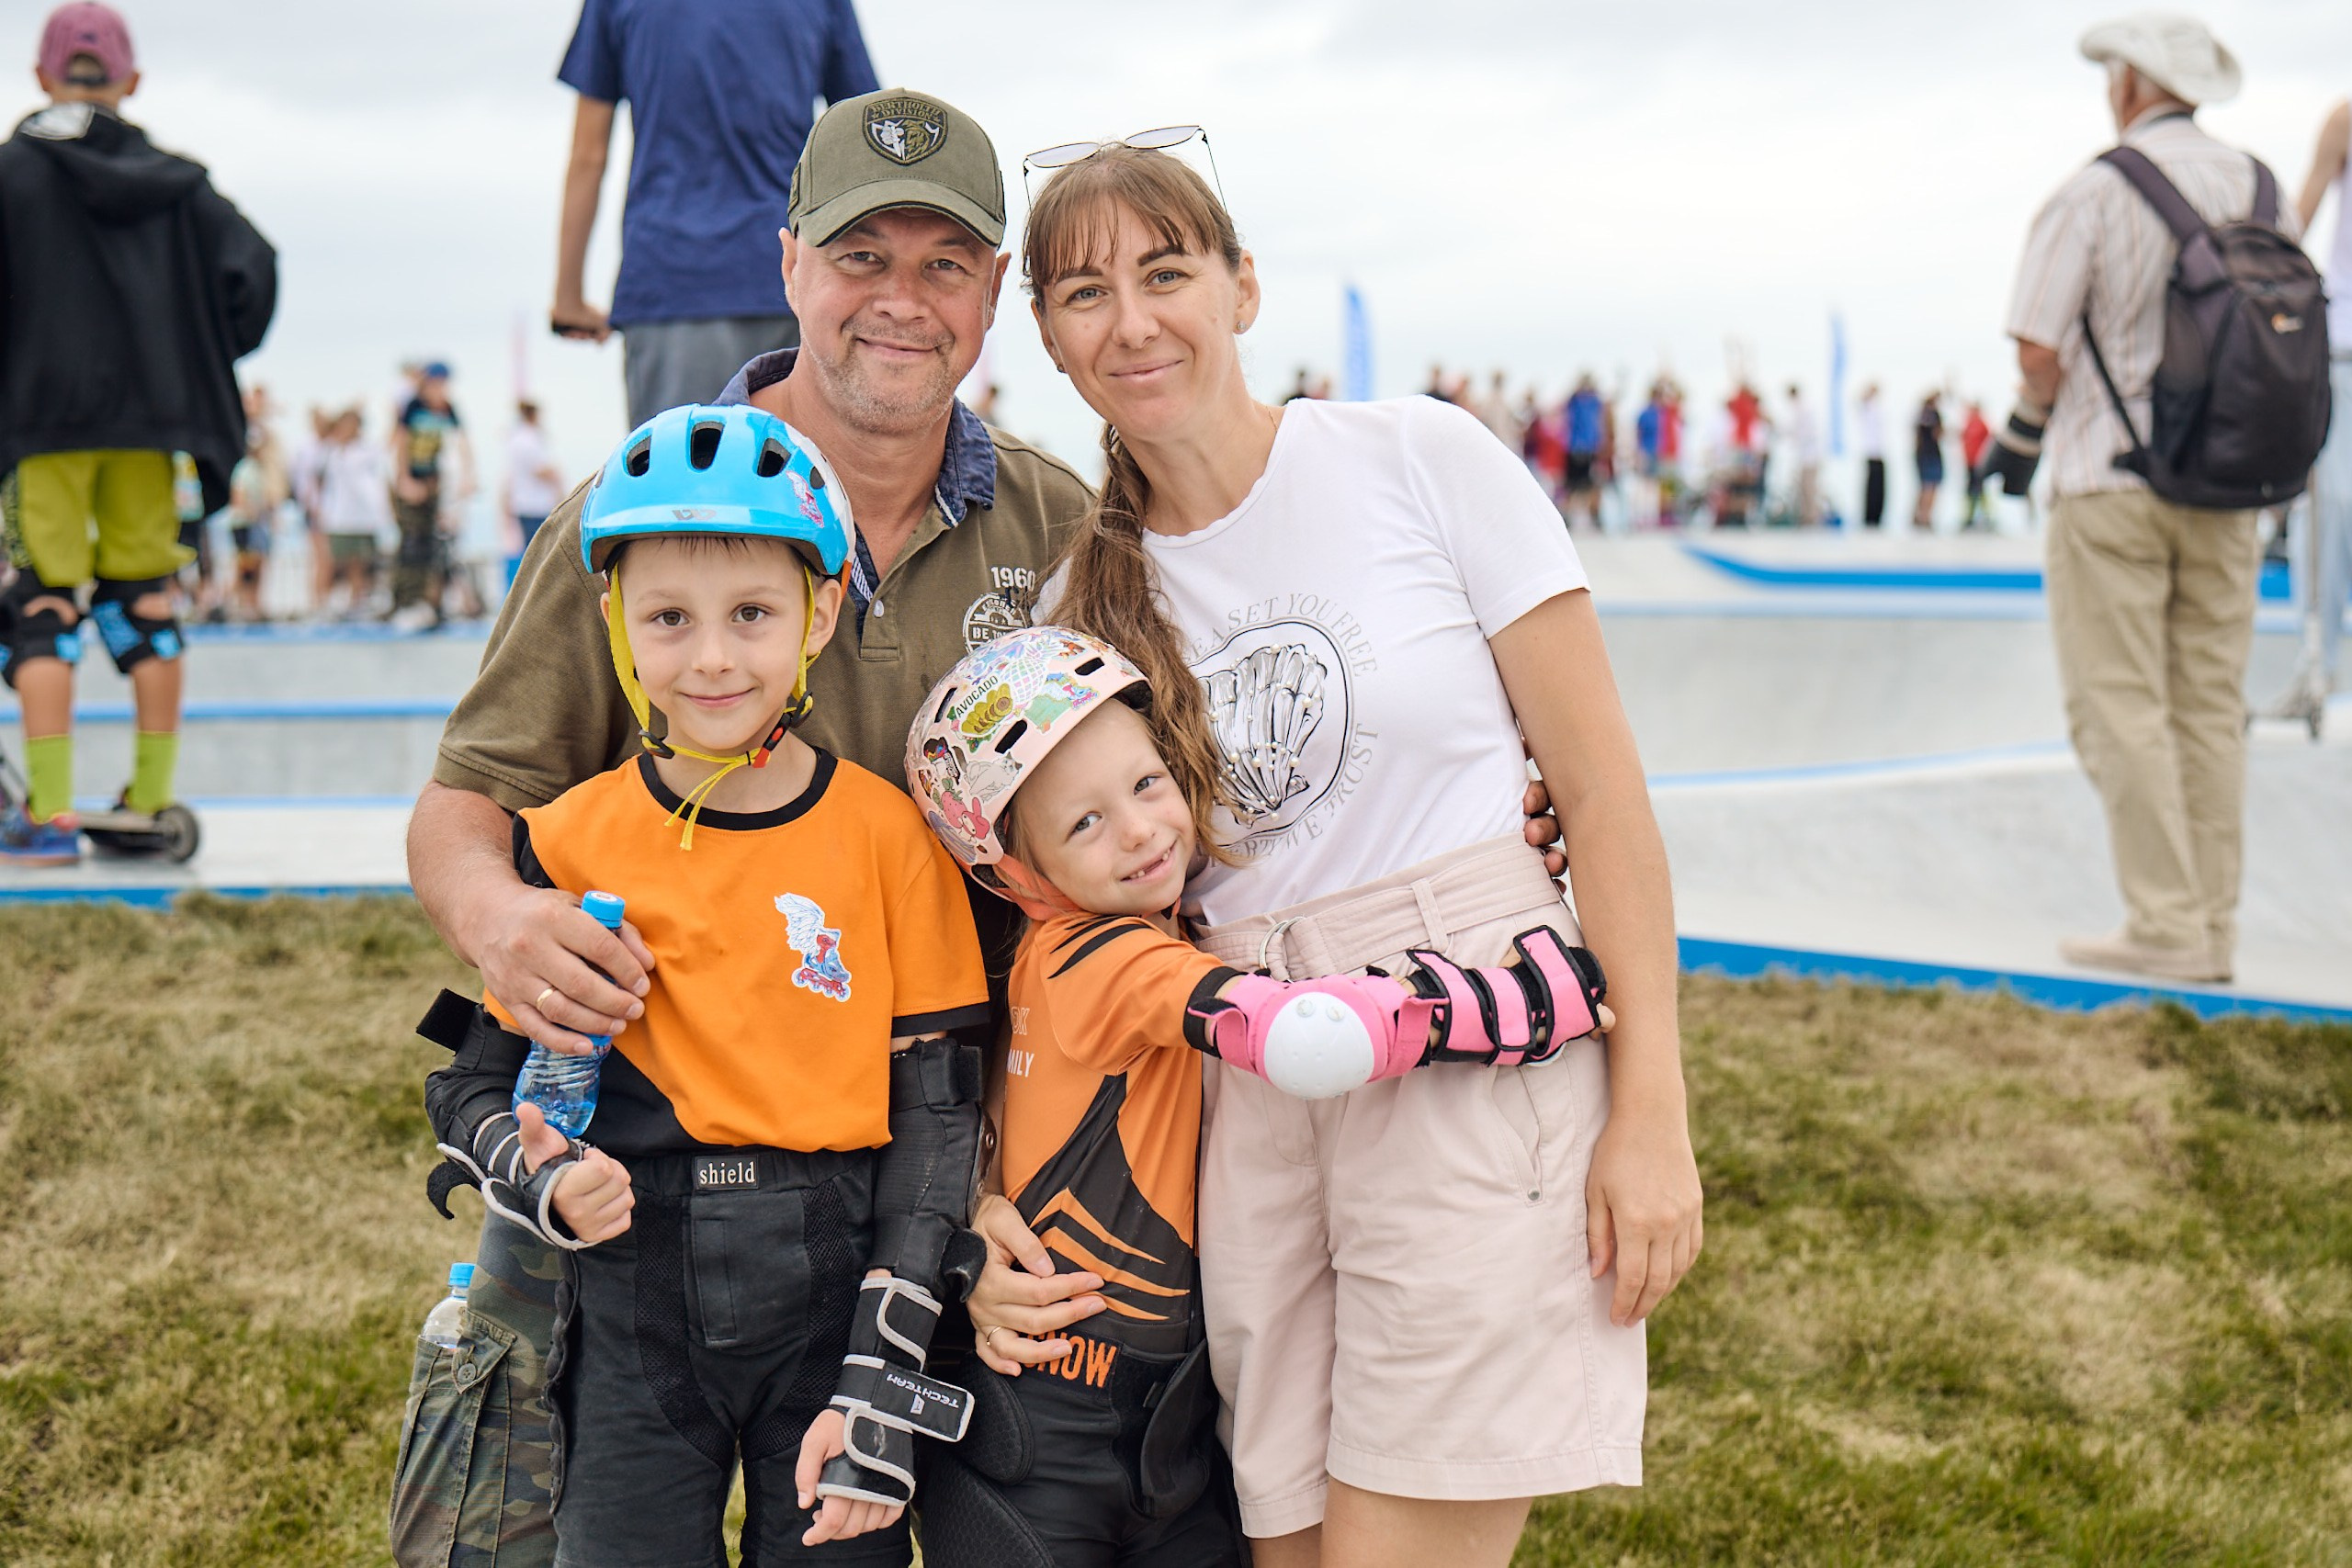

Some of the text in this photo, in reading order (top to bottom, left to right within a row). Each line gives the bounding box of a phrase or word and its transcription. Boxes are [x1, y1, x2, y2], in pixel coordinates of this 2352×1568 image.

[881, 108, 933, 119] DIVISION
[990, 566, 1036, 592] 1960
[972, 626, 990, 640] BE
[1227, 597, 1280, 631] SET
[1286, 592, 1338, 621] YOU
[1330, 610, 1378, 678] FREE
[956, 675, 999, 717] AVOCADO
[1286, 814, 1324, 849] WE
[1324, 723, 1379, 818] TRUST
[699, 1161, 755, 1185] shield
[886, 1373, 959, 1408] TECHTEAM
